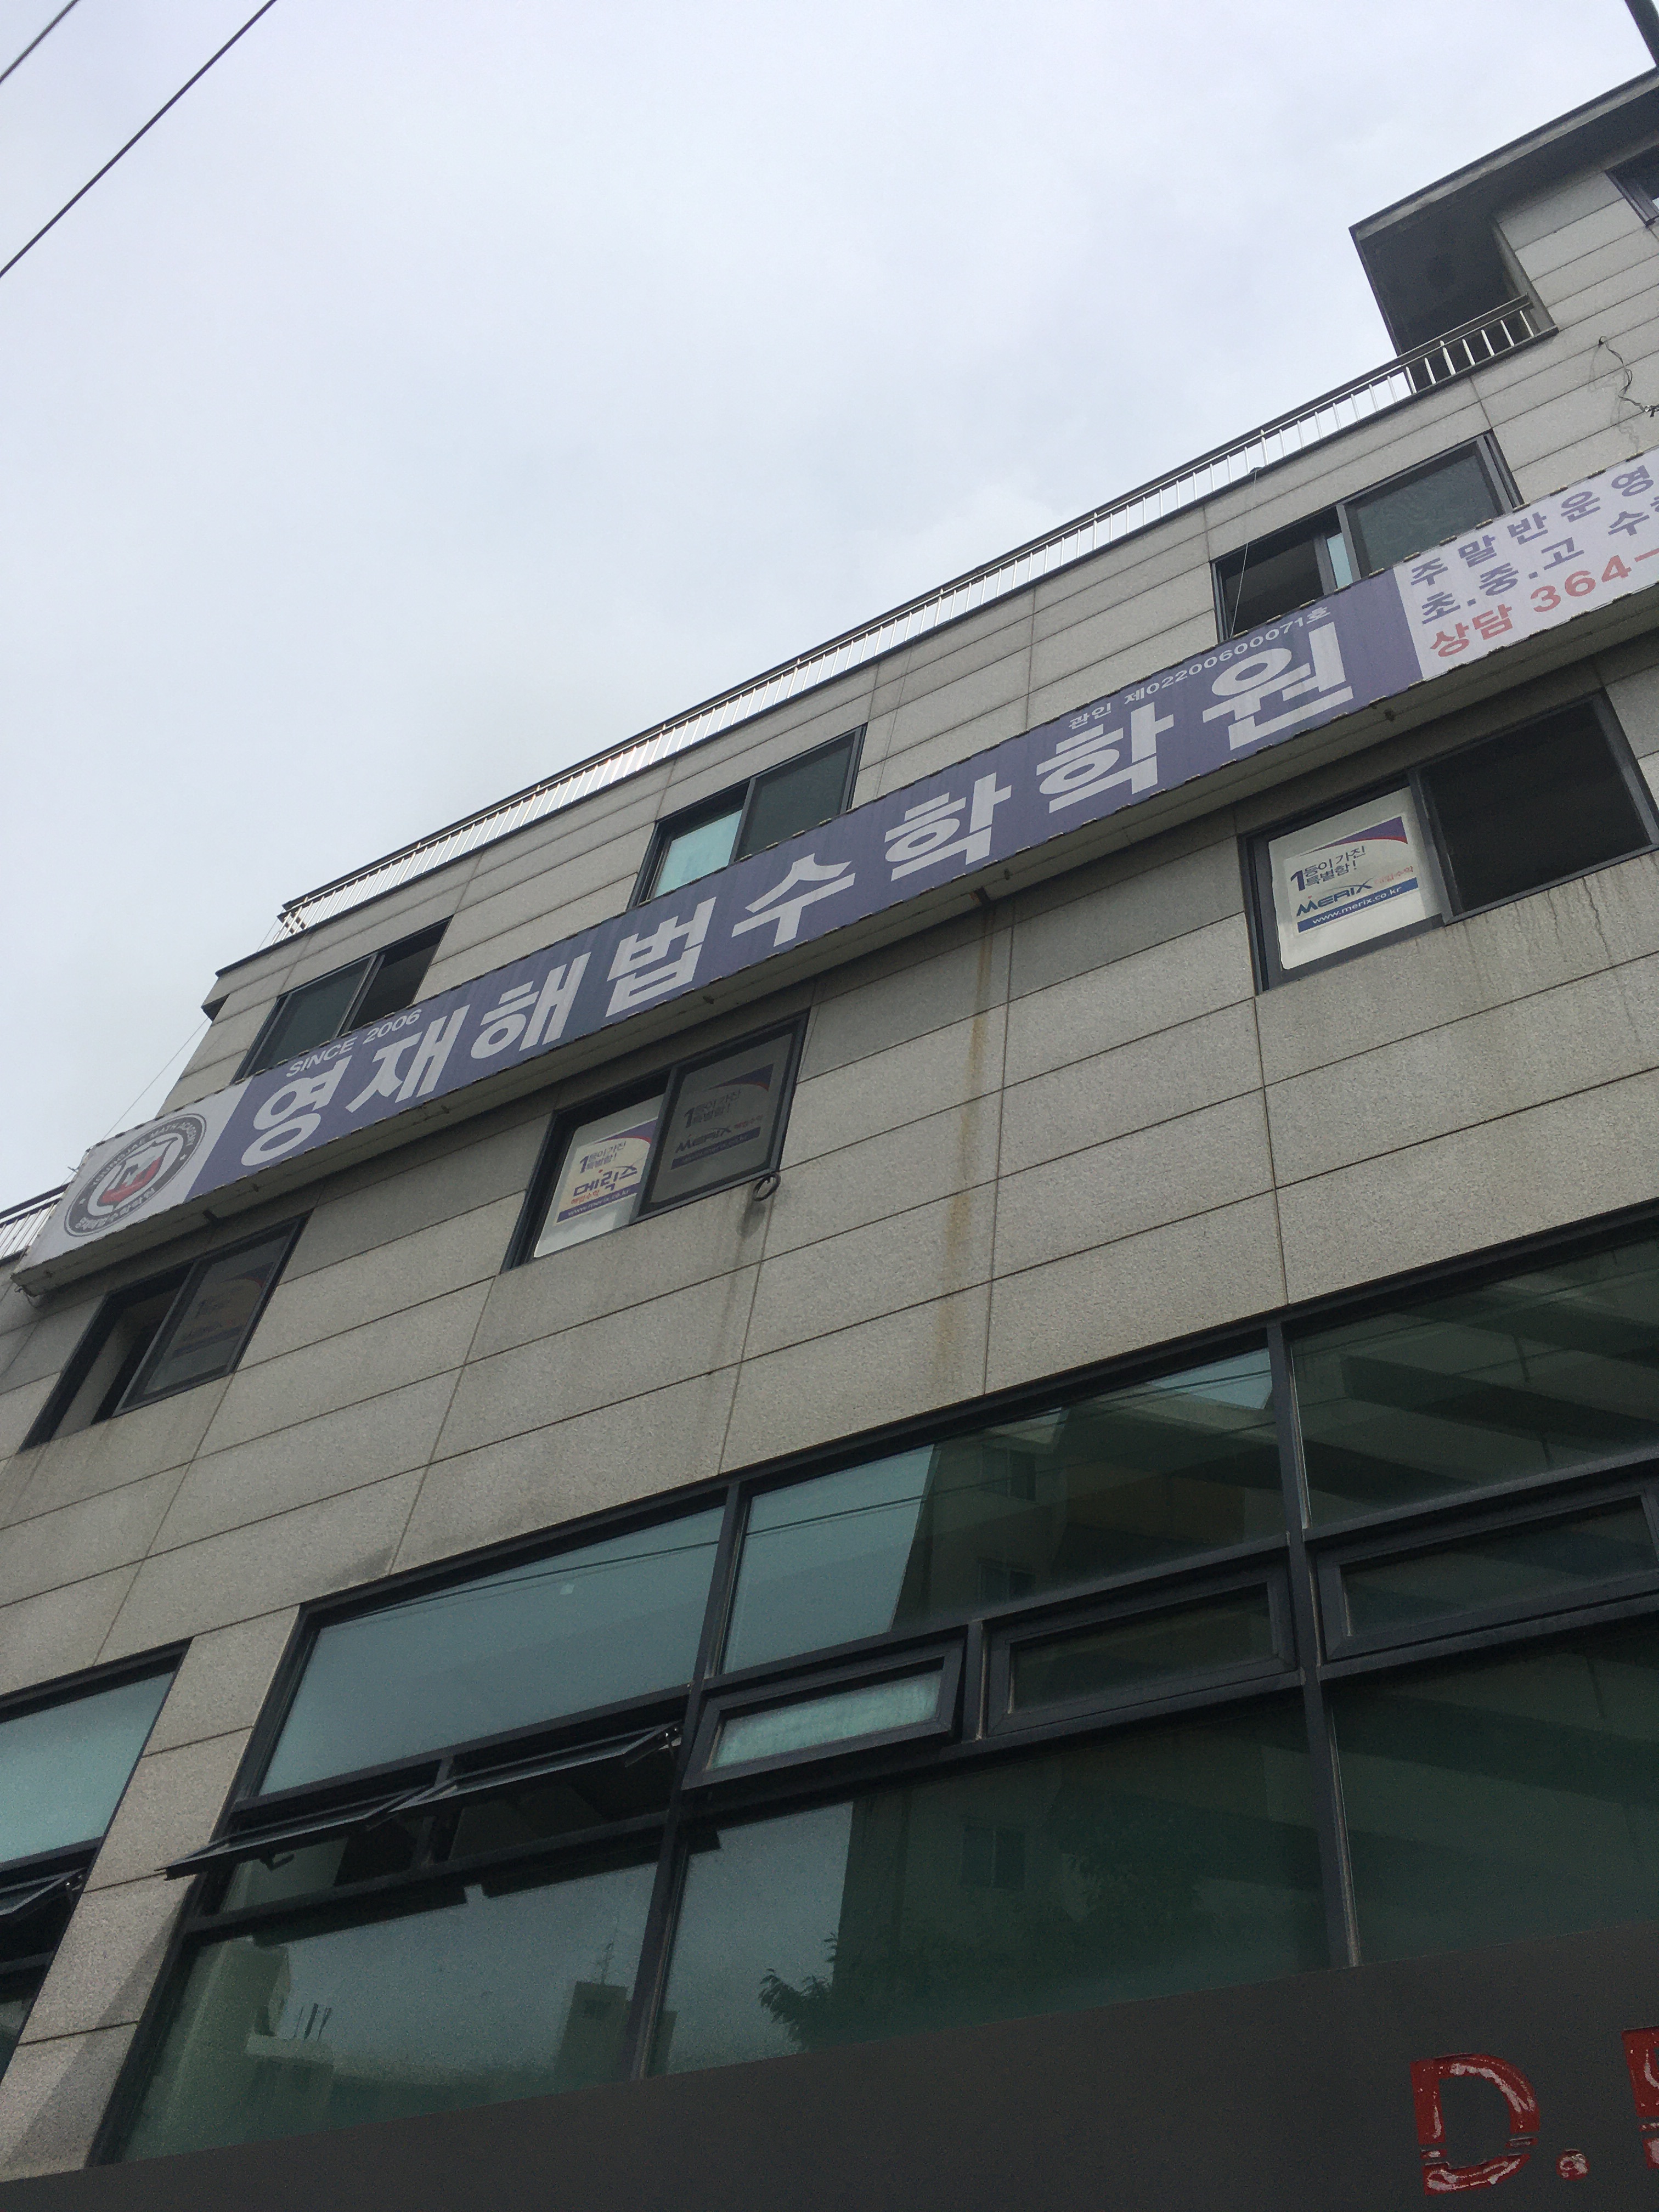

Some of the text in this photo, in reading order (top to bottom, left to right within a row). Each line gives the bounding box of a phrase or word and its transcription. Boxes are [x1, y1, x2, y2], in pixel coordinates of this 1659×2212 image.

[1608, 495, 1659, 536] 수
[1430, 604, 1513, 657] 상담
[1069, 606, 1331, 730] 관인 제02200600071호
[1336, 845, 1366, 865] 가진
[1296, 878, 1373, 917] MERIX
[1312, 886, 1402, 924] www.merix.co.kr
[286, 1009, 422, 1077] SINCE 2006
